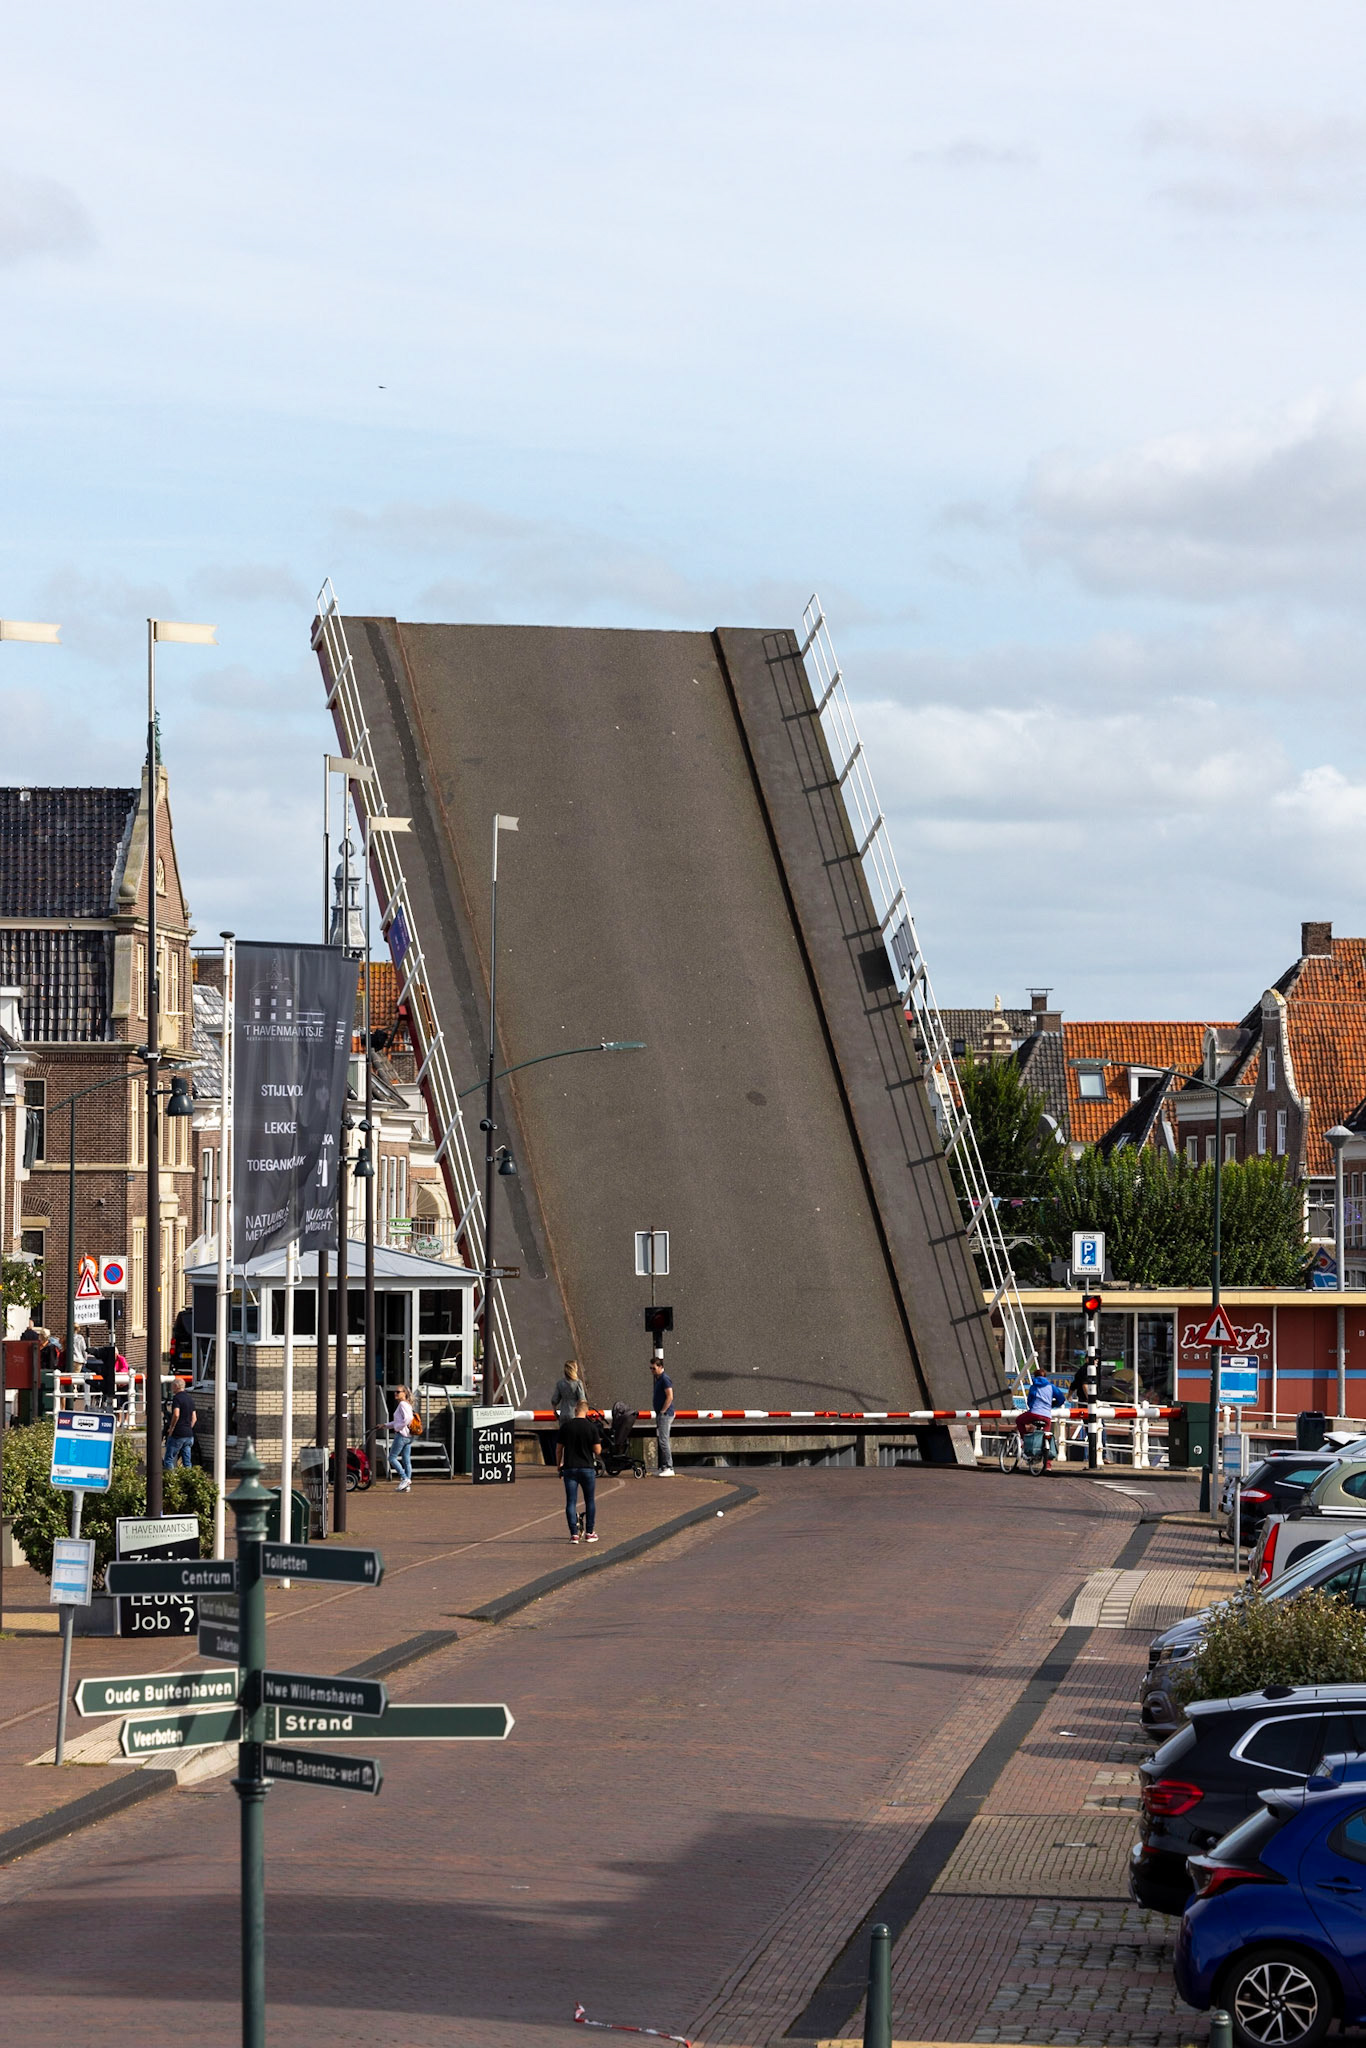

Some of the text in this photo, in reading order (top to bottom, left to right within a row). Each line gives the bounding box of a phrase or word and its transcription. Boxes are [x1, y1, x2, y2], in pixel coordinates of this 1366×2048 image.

[253, 1025, 324, 1038] HAVENMANTSJE
[479, 1428, 512, 1445] Zin in
[479, 1444, 496, 1452] een
[479, 1452, 512, 1465] LEUKE
[479, 1467, 502, 1480] Job
[131, 1523, 195, 1535] HAVENMANTSJE
[265, 1553, 308, 1572] Toiletten
[181, 1570, 232, 1586] Centrum
[131, 1611, 171, 1631] Job
[105, 1682, 232, 1704] Oude Buitenhaven
[266, 1681, 364, 1706] Nwe Willemshaven
[285, 1715, 353, 1731] Strand
[133, 1728, 183, 1748] Veerboten
[265, 1755, 295, 1774] Willem
